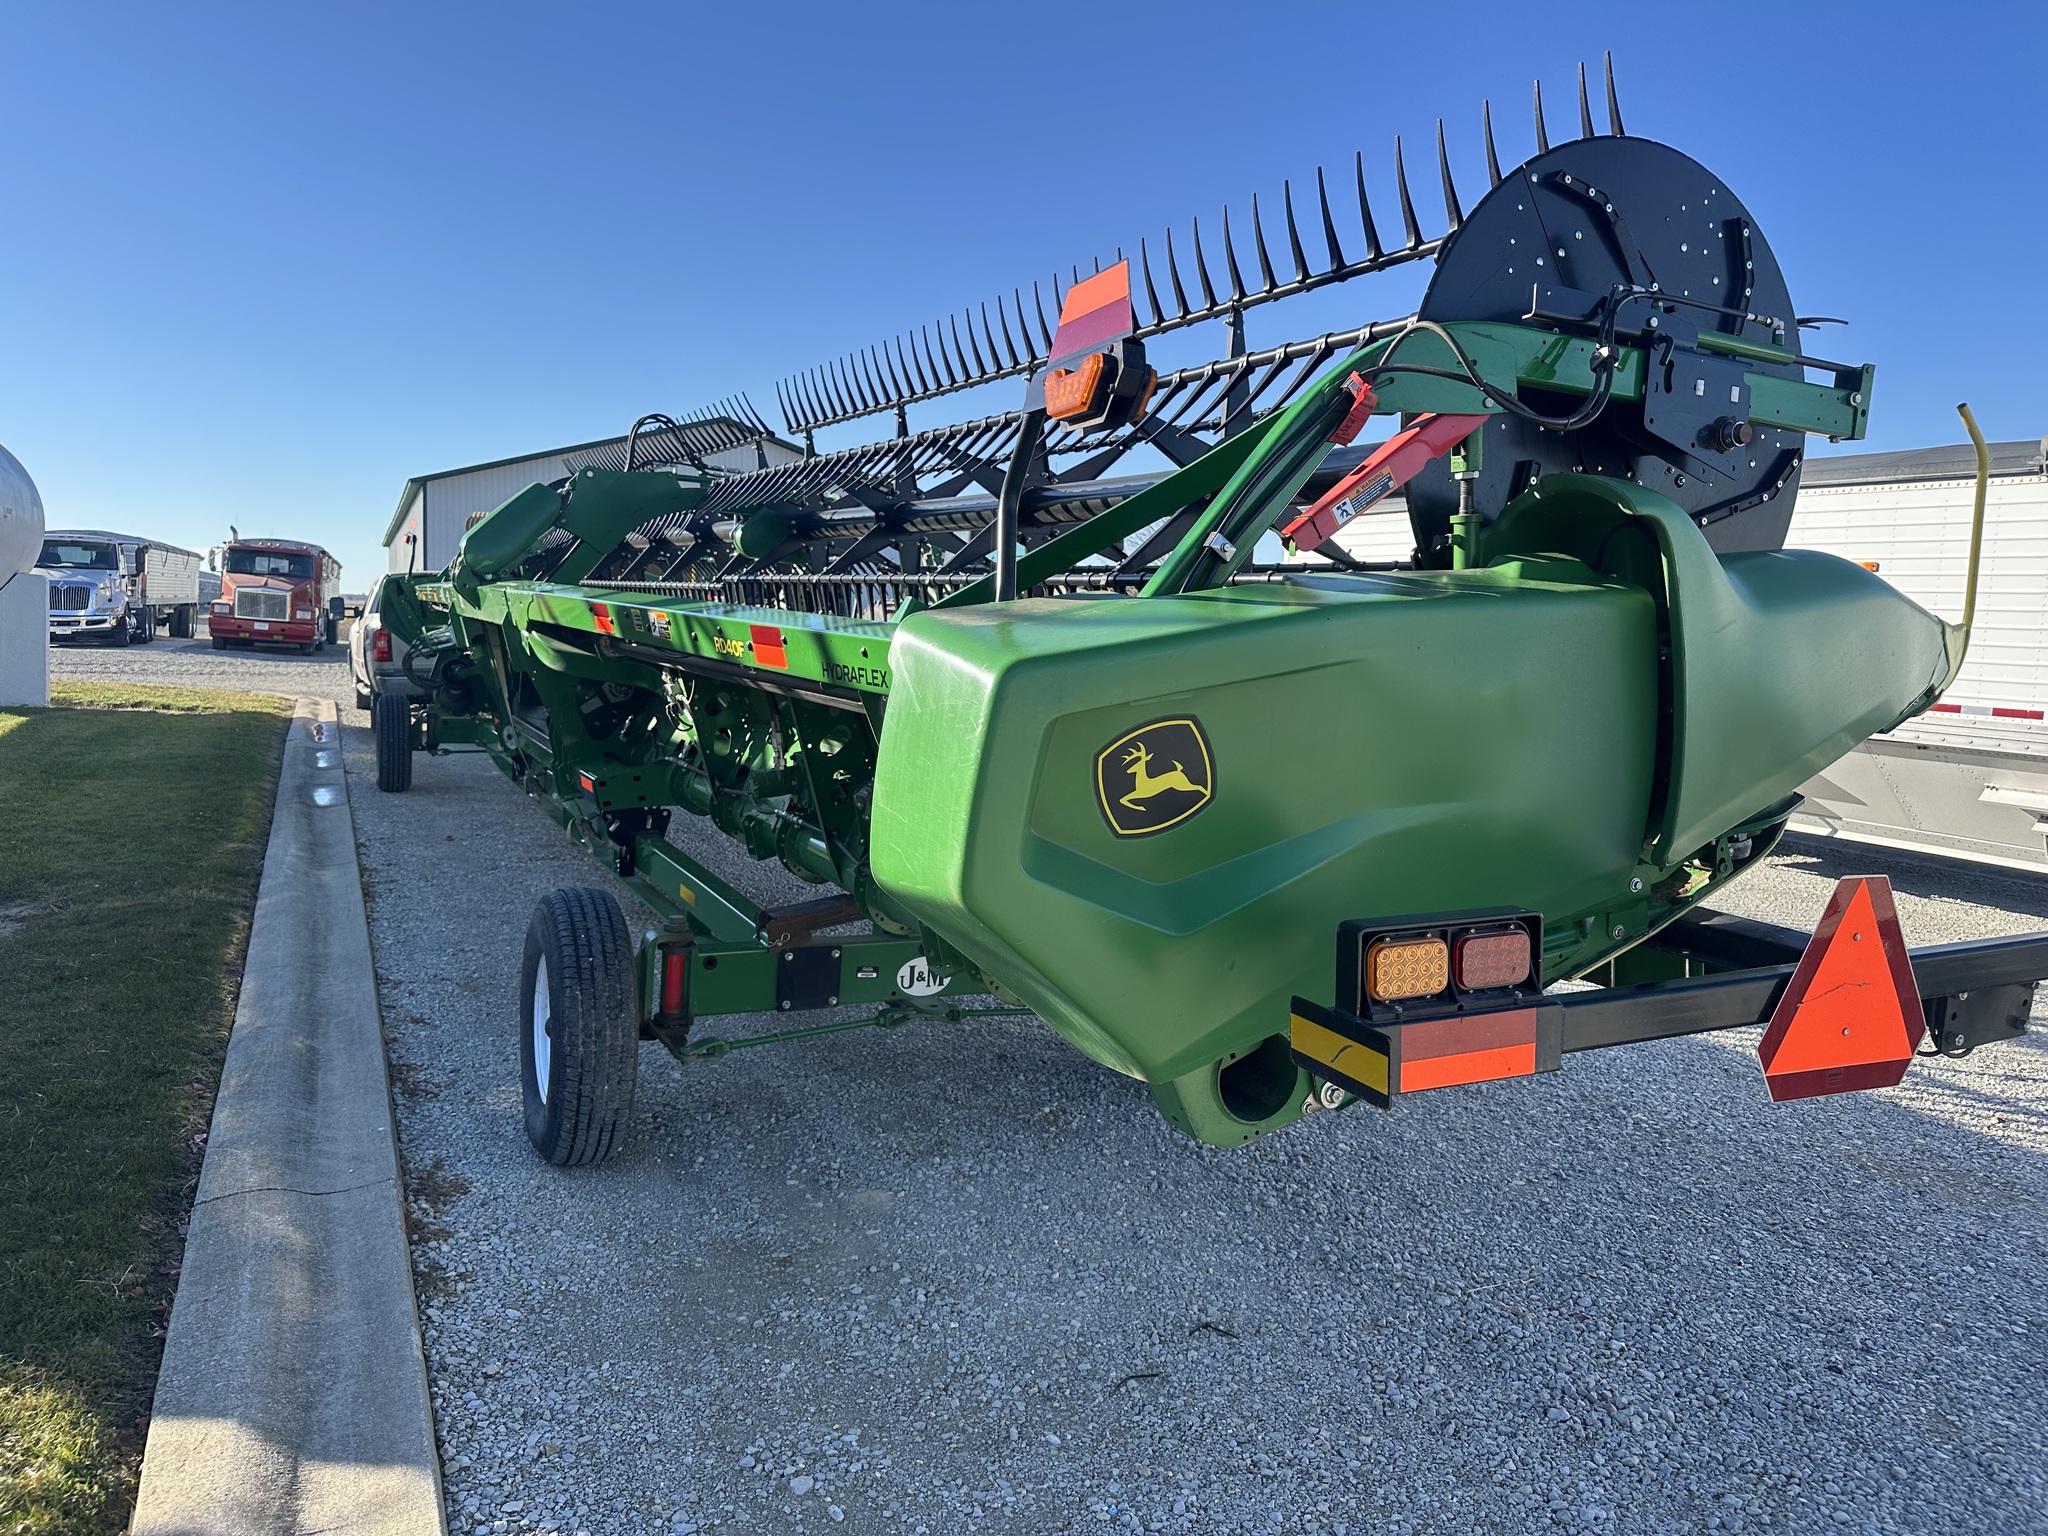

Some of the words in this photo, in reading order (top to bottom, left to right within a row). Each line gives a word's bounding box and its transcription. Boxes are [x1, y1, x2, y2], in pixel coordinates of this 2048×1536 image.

[1360, 471, 1384, 490] WARNING
[713, 636, 745, 658] RD40F
[821, 661, 889, 688] HYDRAFLEX
[900, 964, 945, 990] J&M
